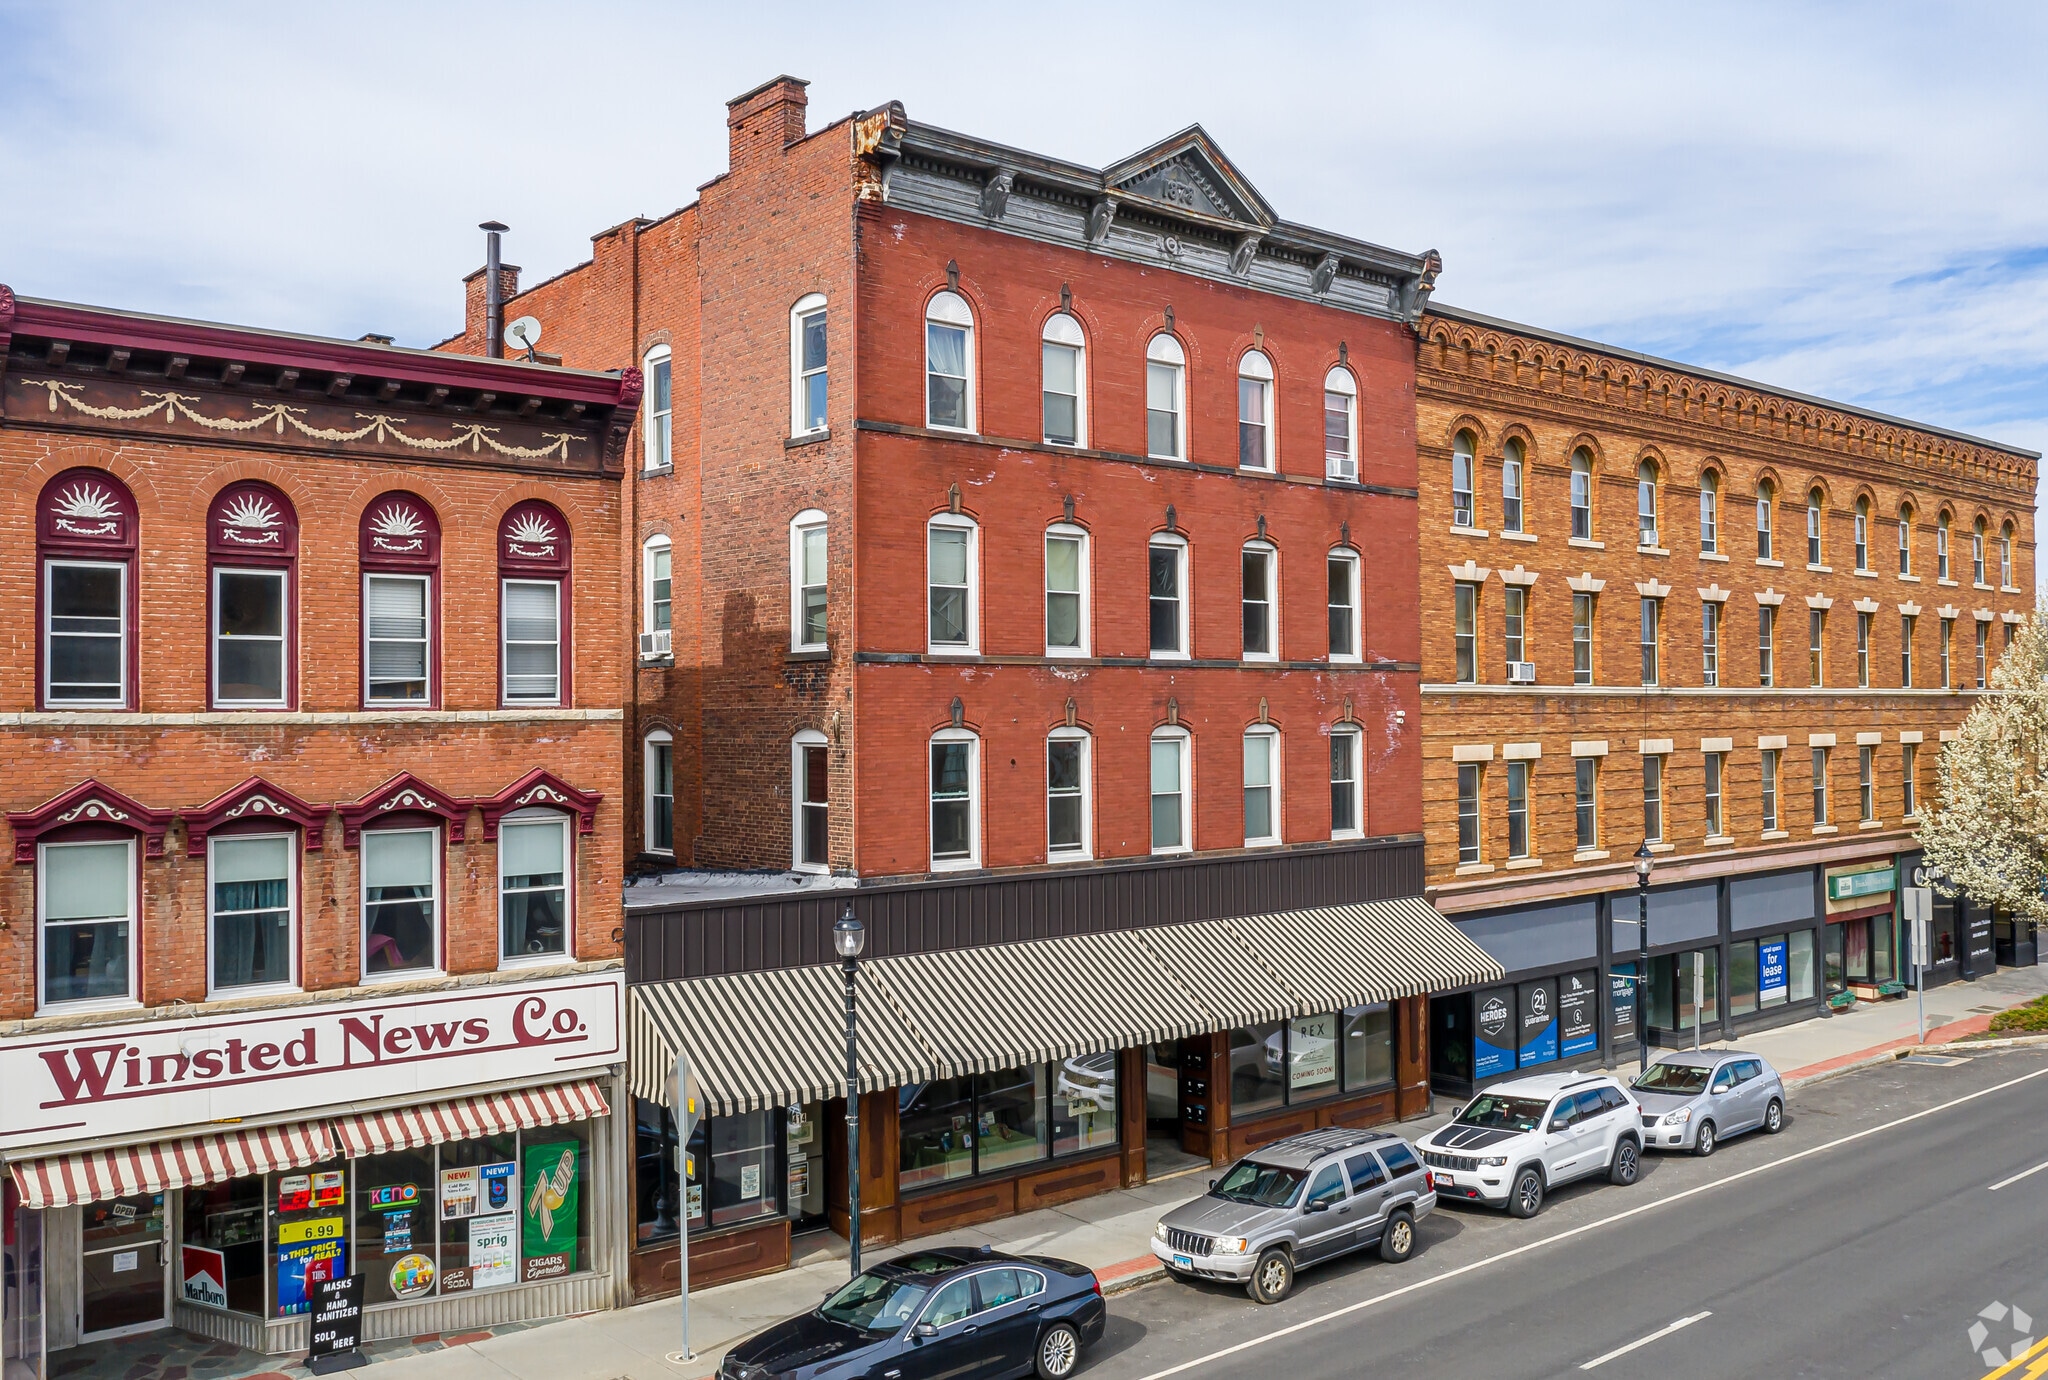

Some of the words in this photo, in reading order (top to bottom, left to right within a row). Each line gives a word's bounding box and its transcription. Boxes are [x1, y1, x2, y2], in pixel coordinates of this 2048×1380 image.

[1767, 953, 1778, 965] for
[1763, 965, 1782, 977] lease
[1613, 977, 1625, 988] total
[1534, 993, 1544, 1009] 21
[1480, 1007, 1507, 1023] HEROES
[1524, 1014, 1550, 1028] guarantee
[1301, 1023, 1324, 1039] REX
[39, 1028, 318, 1101] Winsted
[340, 1015, 489, 1066] News
[512, 996, 587, 1047] Co.
[1292, 1069, 1315, 1080] COMING
[447, 1171, 470, 1181] NEW!
[486, 1166, 509, 1176] NEW!
[371, 1184, 418, 1204] KENO
[115, 1205, 135, 1216] OPEN
[305, 1225, 334, 1238] 6.99
[477, 1234, 507, 1249] sprig
[280, 1253, 288, 1262] Is
[289, 1247, 310, 1259] THIS
[311, 1241, 337, 1254] PRICE
[299, 1255, 313, 1264] for
[313, 1247, 342, 1261] REAL?
[529, 1255, 563, 1268] CIGARS
[443, 1270, 465, 1285] COLD
[447, 1279, 471, 1289] SODA
[323, 1279, 352, 1293] MASKS
[185, 1282, 225, 1306] Marlboro
[326, 1299, 348, 1311] HAND
[316, 1306, 358, 1323] SANITIZER
[314, 1330, 336, 1343] SOLD
[333, 1336, 354, 1349] HERE
